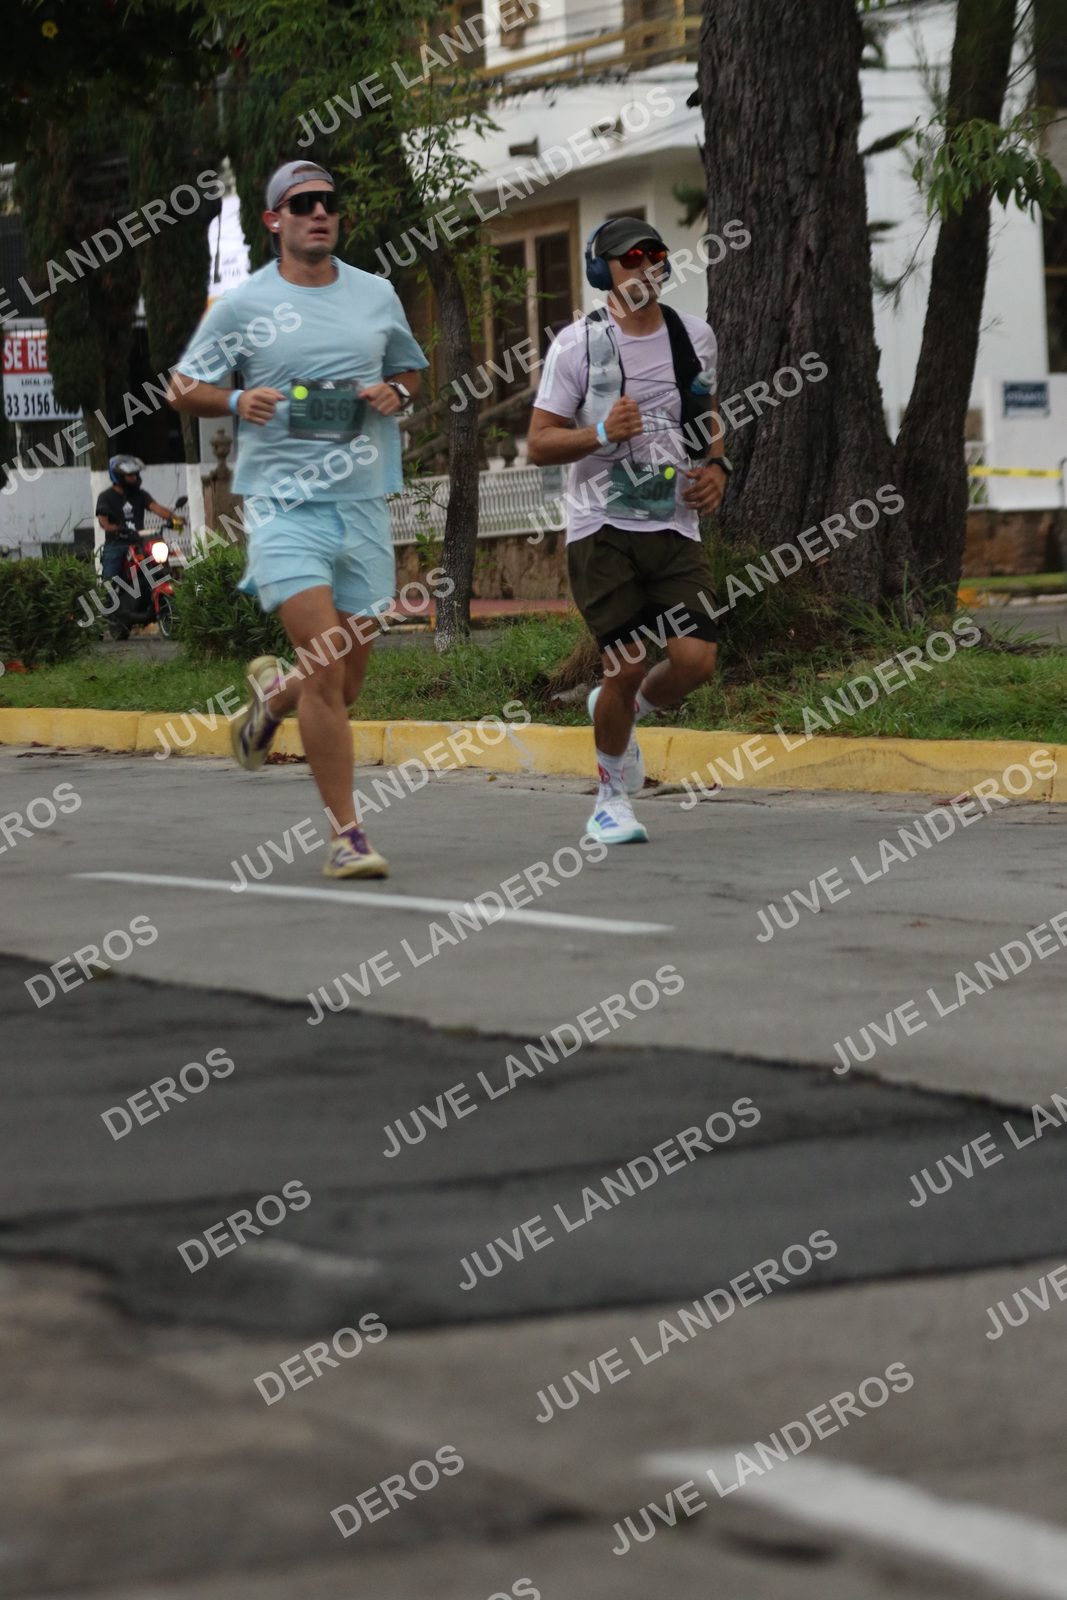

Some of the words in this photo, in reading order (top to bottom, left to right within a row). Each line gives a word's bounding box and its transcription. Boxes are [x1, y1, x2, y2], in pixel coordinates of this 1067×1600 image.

[4, 338, 23, 371] SE
[6, 394, 20, 416] 33
[23, 393, 51, 416] 3156
